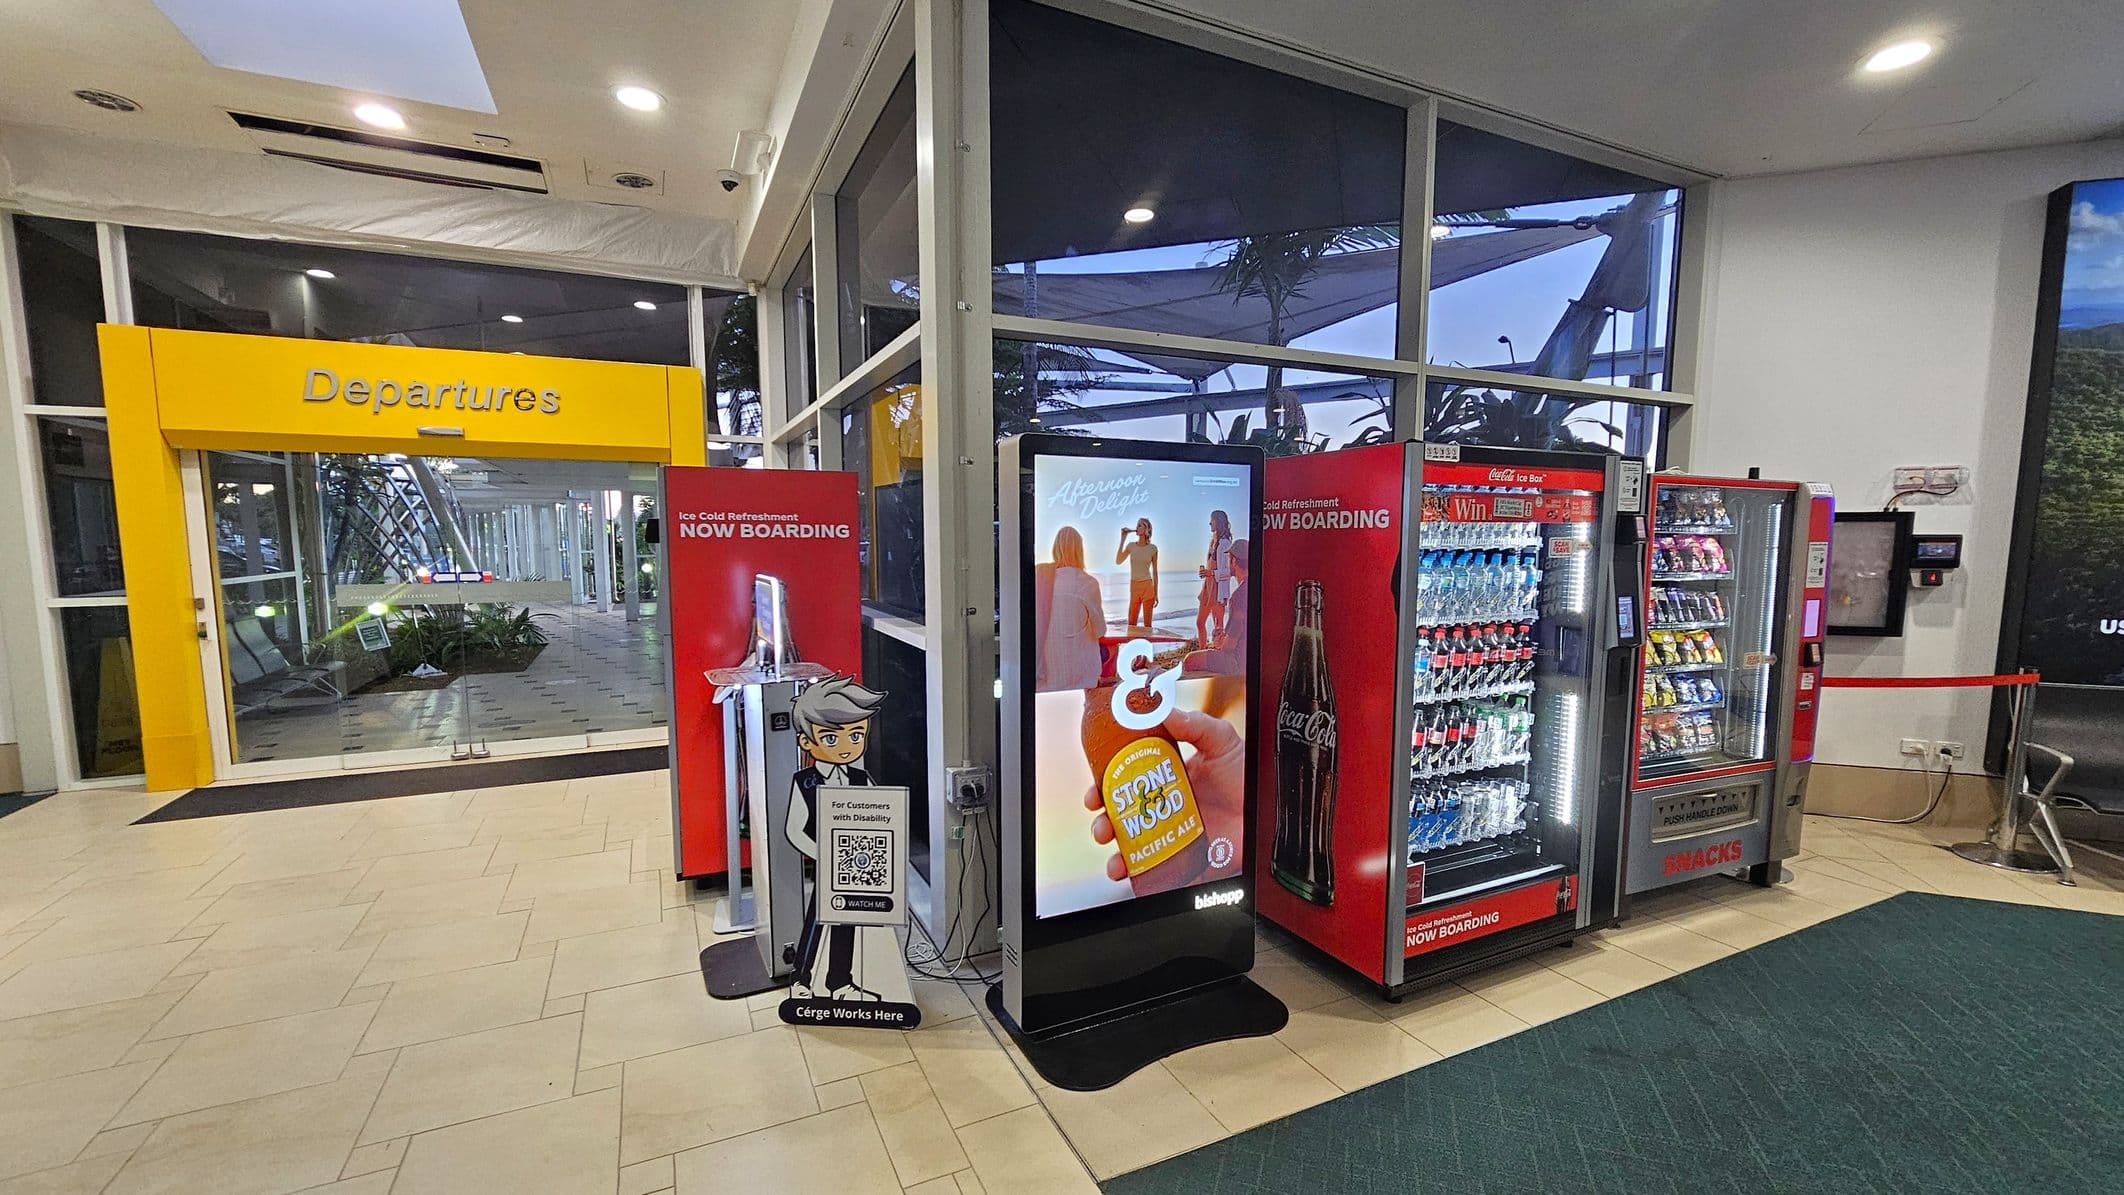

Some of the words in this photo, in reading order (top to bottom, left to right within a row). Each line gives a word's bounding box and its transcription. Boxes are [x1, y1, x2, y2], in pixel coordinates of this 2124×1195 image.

[303, 367, 561, 415] Departures
[1517, 474, 1528, 483] Ice
[1048, 473, 1146, 509] Afternoon
[1080, 487, 1151, 520] Delight
[1281, 497, 1339, 510] Refreshment
[1455, 498, 1487, 520] Win
[678, 512, 696, 521] Ice
[698, 512, 725, 521] Cold
[728, 512, 799, 522] Refreshment
[1289, 509, 1390, 530] BOARDING
[679, 523, 735, 538] NOW
[740, 524, 850, 539] BOARDING
[1112, 765, 1124, 779] THE
[1125, 747, 1161, 766] ORIGINAL
[1112, 758, 1177, 814] STONE
[832, 801, 845, 809] For
[846, 802, 890, 810] Customers
[1121, 789, 1184, 839] WOOD
[1663, 813, 1685, 826] PUSH
[1686, 808, 1716, 821] HANDLE
[1717, 804, 1739, 817] DOWN
[853, 814, 891, 824] Disability
[1129, 830, 1176, 864] PACIFIC
[1177, 815, 1197, 837] ALE
[1663, 839, 1744, 876] SNACKS
[848, 900, 874, 908] WATCH
[875, 900, 886, 908] ME
[1194, 888, 1245, 910] bishopp
[1406, 931, 1437, 947] NOW
[1439, 911, 1500, 938] BOARDING
[1407, 923, 1417, 933] Ice
[1418, 921, 1433, 931] Cold
[1433, 910, 1473, 927] Refreshment
[796, 1005, 831, 1022] Cérge
[833, 1007, 872, 1020] Works
[875, 1009, 904, 1022] Here
